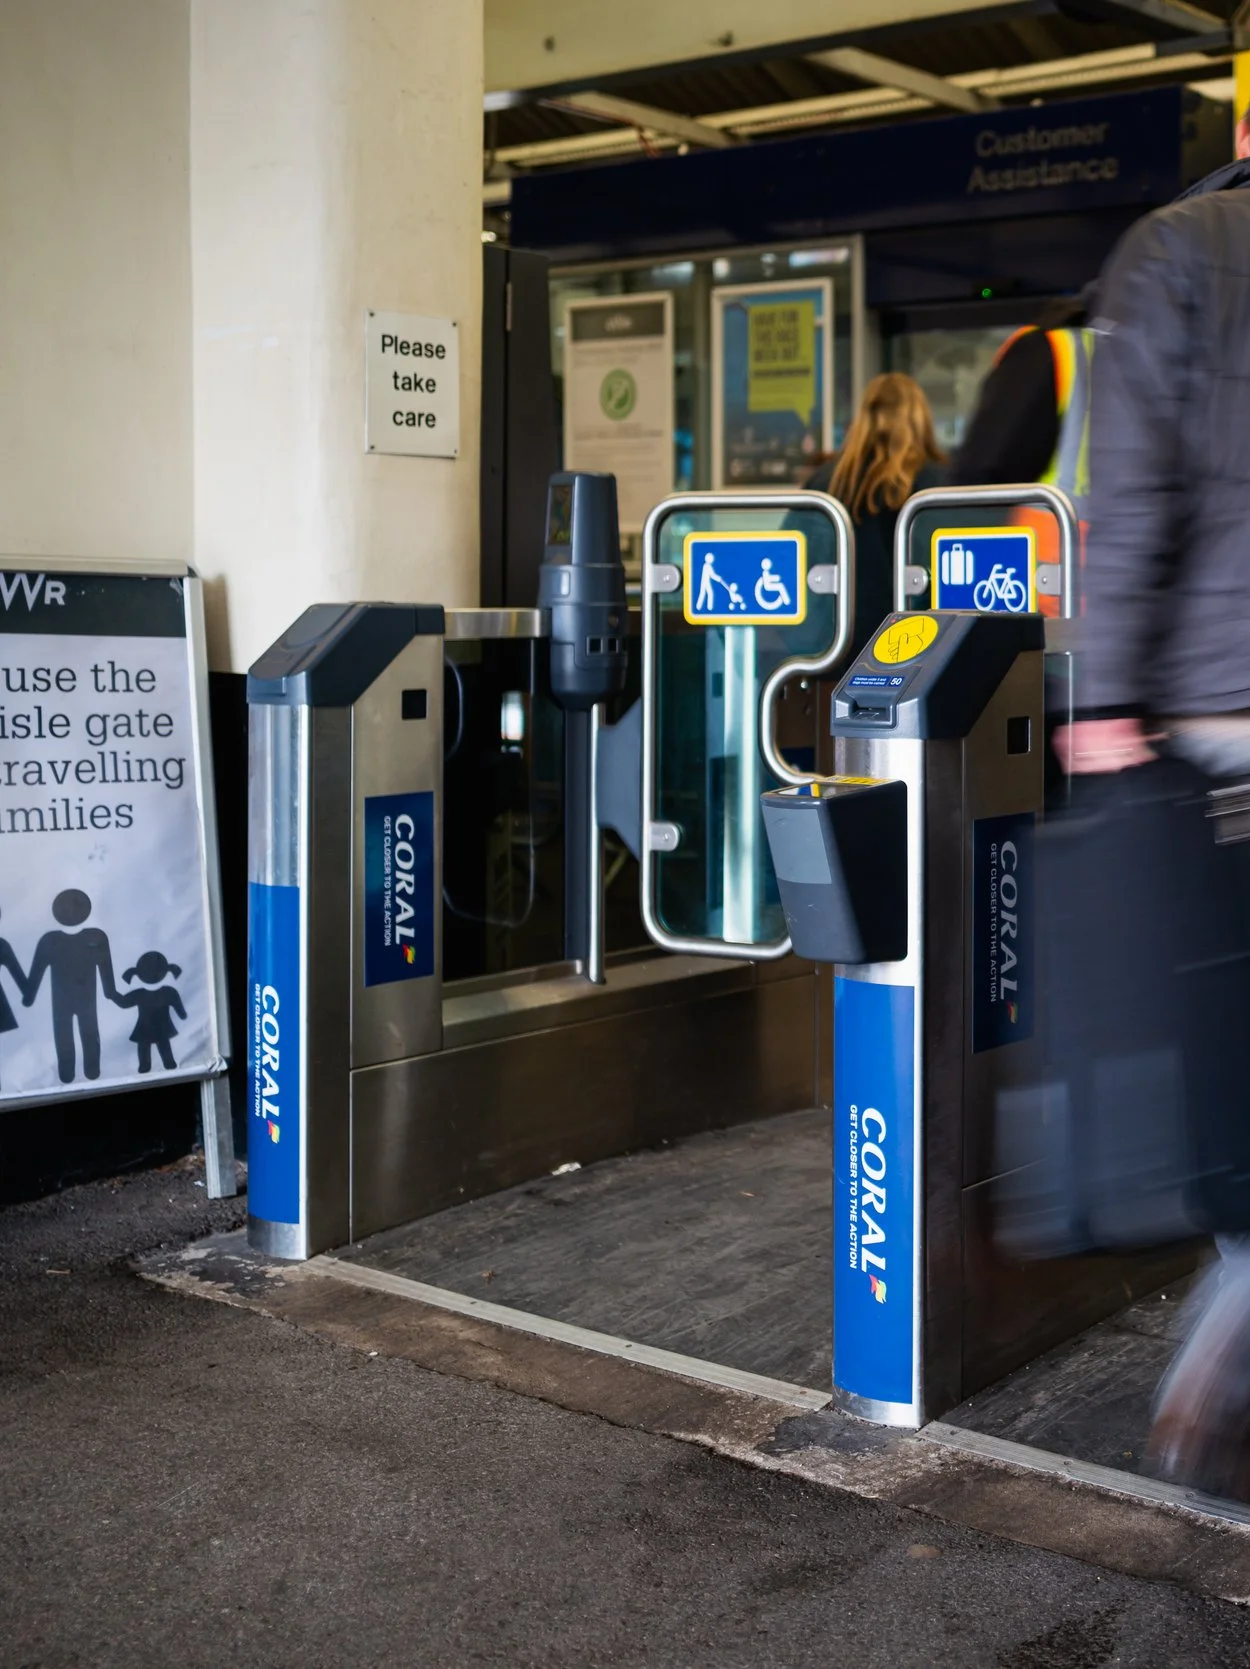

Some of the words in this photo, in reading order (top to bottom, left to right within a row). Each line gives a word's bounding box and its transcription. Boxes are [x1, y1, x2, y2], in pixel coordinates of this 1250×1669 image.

[976, 122, 1110, 157] Customer
[967, 157, 1118, 194] Assistance
[381, 334, 446, 360] Please
[392, 370, 436, 393] take
[392, 410, 436, 428] care
[2, 667, 77, 693] use
[90, 661, 156, 693] the
[890, 678, 902, 686] 50
[0, 706, 71, 739] isle
[85, 709, 174, 746] gate
[0, 751, 186, 790] ravelling
[0, 798, 133, 834] milies
[384, 815, 392, 836] GET
[384, 836, 392, 874] CLOSER
[384, 875, 392, 888] TO
[395, 814, 415, 945] CORAL
[384, 890, 392, 911] THE
[384, 911, 392, 946] ACTION
[990, 916, 997, 932] TO
[1000, 840, 1018, 1000] CORAL
[262, 985, 280, 1119] CORAL
[850, 1104, 858, 1130] GET
[850, 1131, 858, 1179] CLOSER
[850, 1180, 858, 1196] TO
[861, 1107, 886, 1273] CORAL
[850, 1198, 858, 1223] THE
[850, 1223, 858, 1269] ACTION
